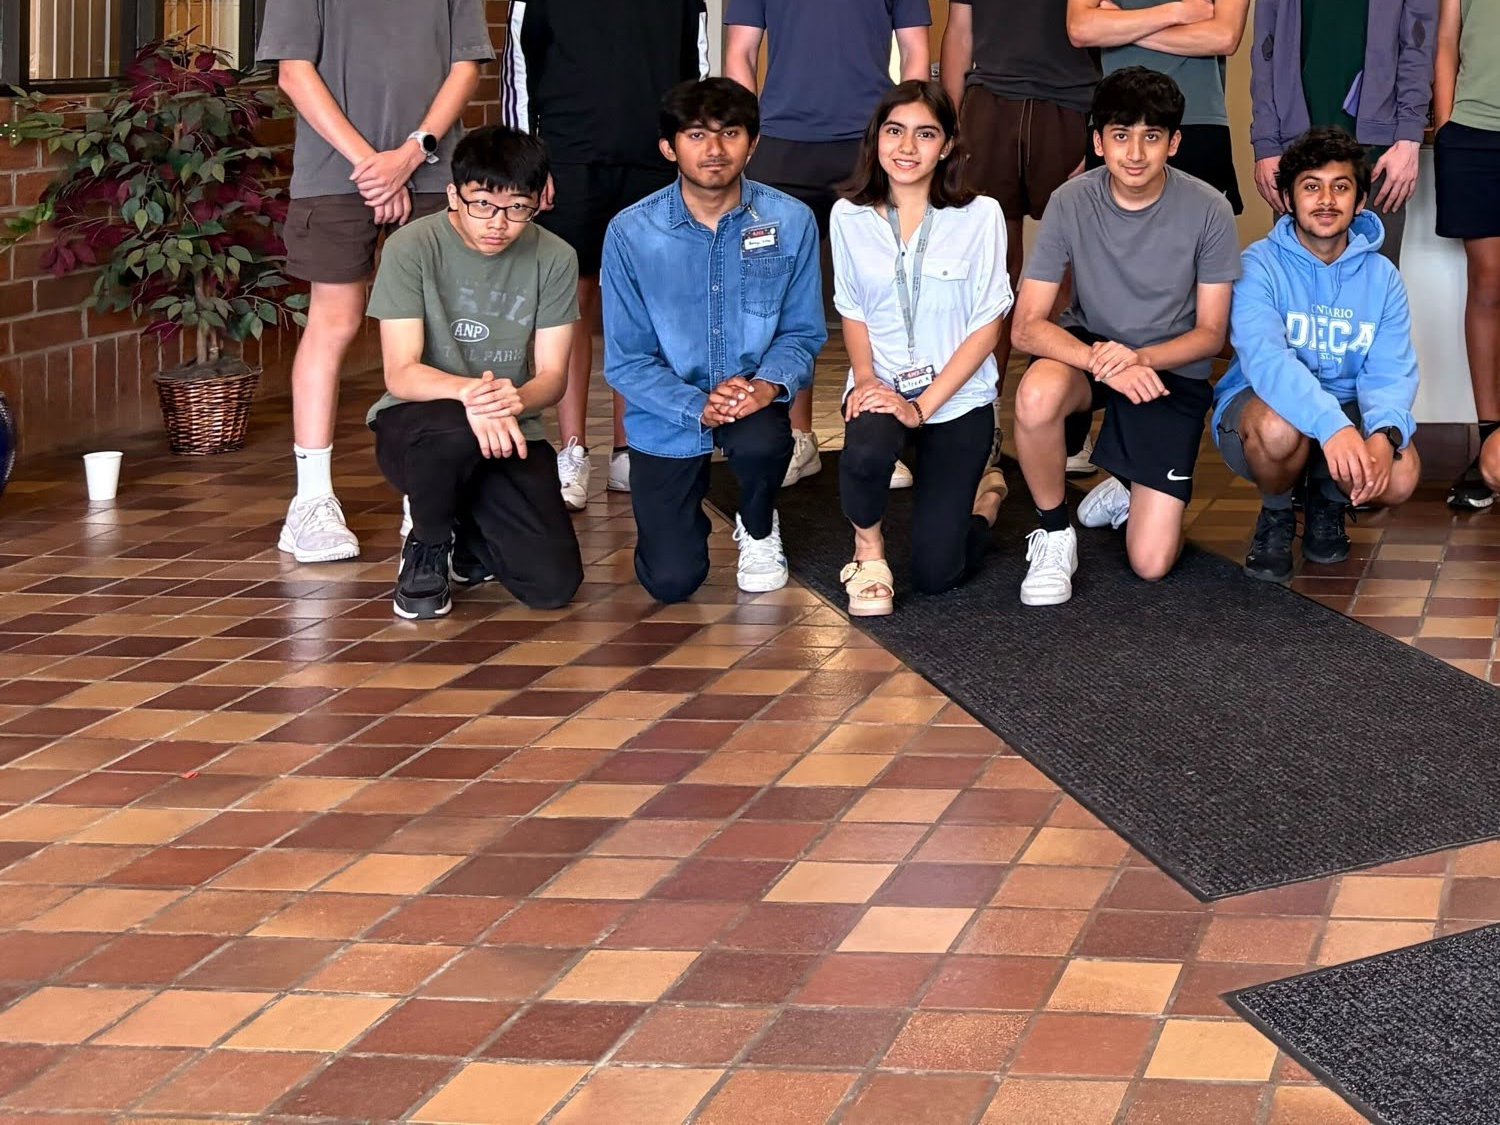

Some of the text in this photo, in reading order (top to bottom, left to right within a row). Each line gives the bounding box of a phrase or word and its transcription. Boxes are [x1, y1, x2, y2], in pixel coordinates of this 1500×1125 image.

[454, 322, 484, 339] ANP
[1286, 311, 1376, 355] DECA
[483, 348, 523, 363] PARK
